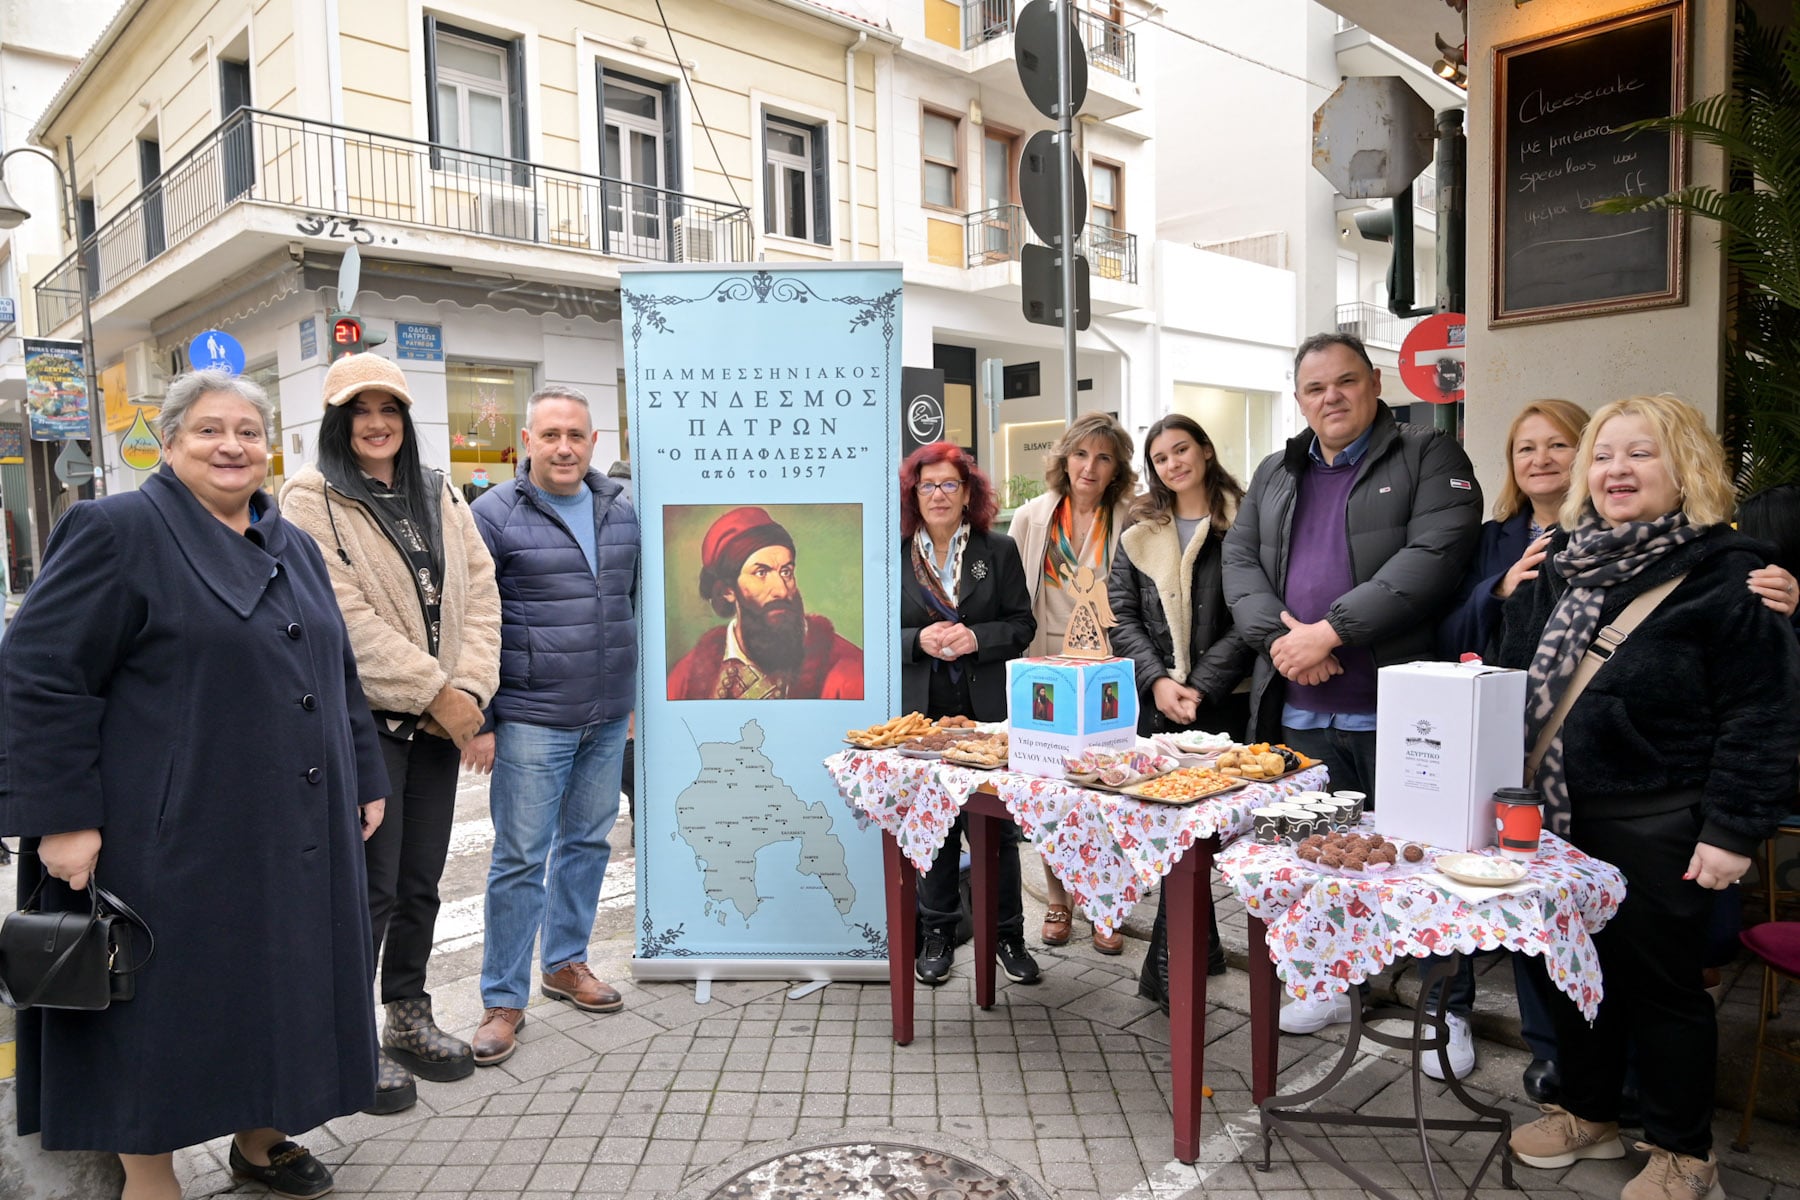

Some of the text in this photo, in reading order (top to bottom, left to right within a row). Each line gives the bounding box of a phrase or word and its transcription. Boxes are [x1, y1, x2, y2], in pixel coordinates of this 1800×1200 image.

[1519, 74, 1645, 124] Cheesecake
[1518, 157, 1597, 193] speculoos
[335, 325, 357, 342] 21
[402, 332, 436, 341] ΠΑΤΡΕΩΣ
[408, 326, 429, 334] ΟΔΟΣ
[645, 366, 881, 381] ΠΑΜΜΕΣΣΗΝΙΑΚΟΣ
[648, 389, 877, 409] ΣΥΝΔΕΣΜΟΣ
[689, 417, 838, 437] ΠΑΤΡΩΝ
[701, 466, 827, 480] από το 1957
